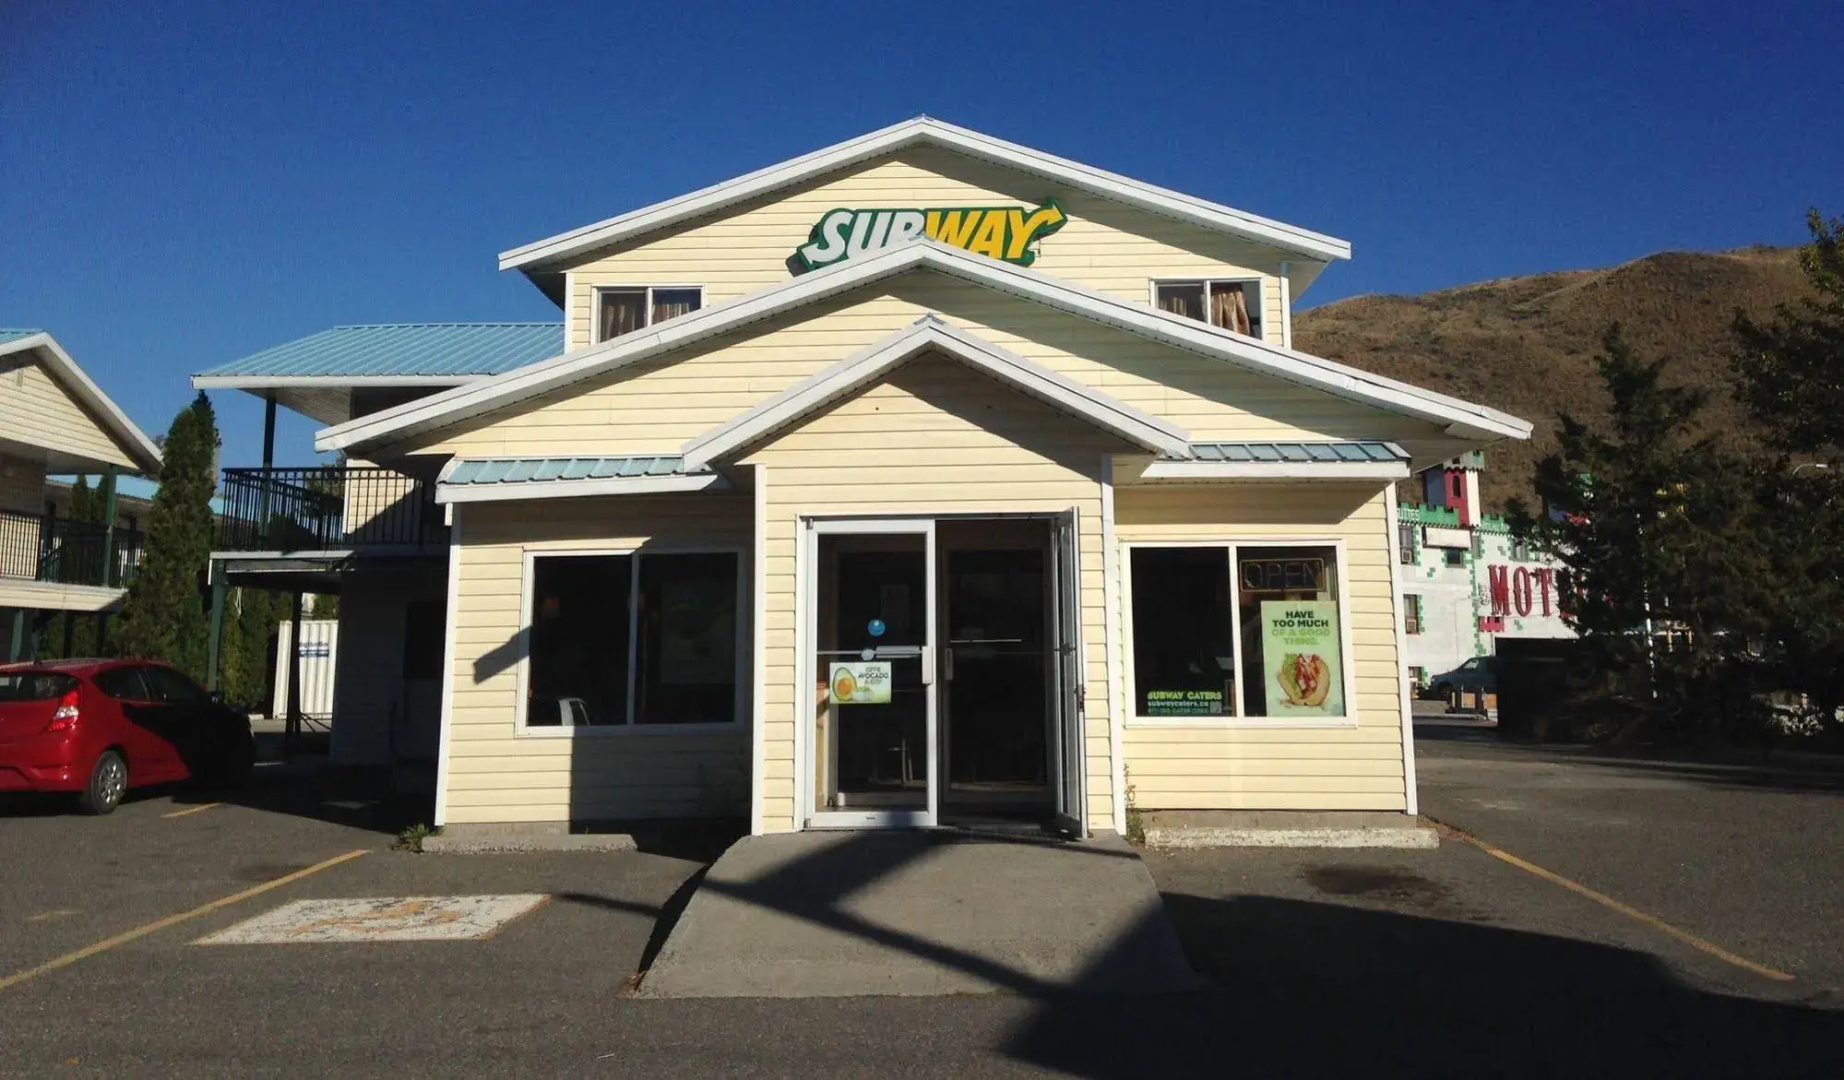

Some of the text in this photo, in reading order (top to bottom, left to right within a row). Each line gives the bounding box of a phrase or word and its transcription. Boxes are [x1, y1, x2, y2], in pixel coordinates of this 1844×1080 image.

[801, 204, 1066, 264] SUBWAY
[1244, 562, 1320, 588] OPEN
[1285, 611, 1314, 619] HAVE
[1299, 629, 1331, 637] GOOD
[1147, 691, 1222, 699] SUBWAY CATERS
